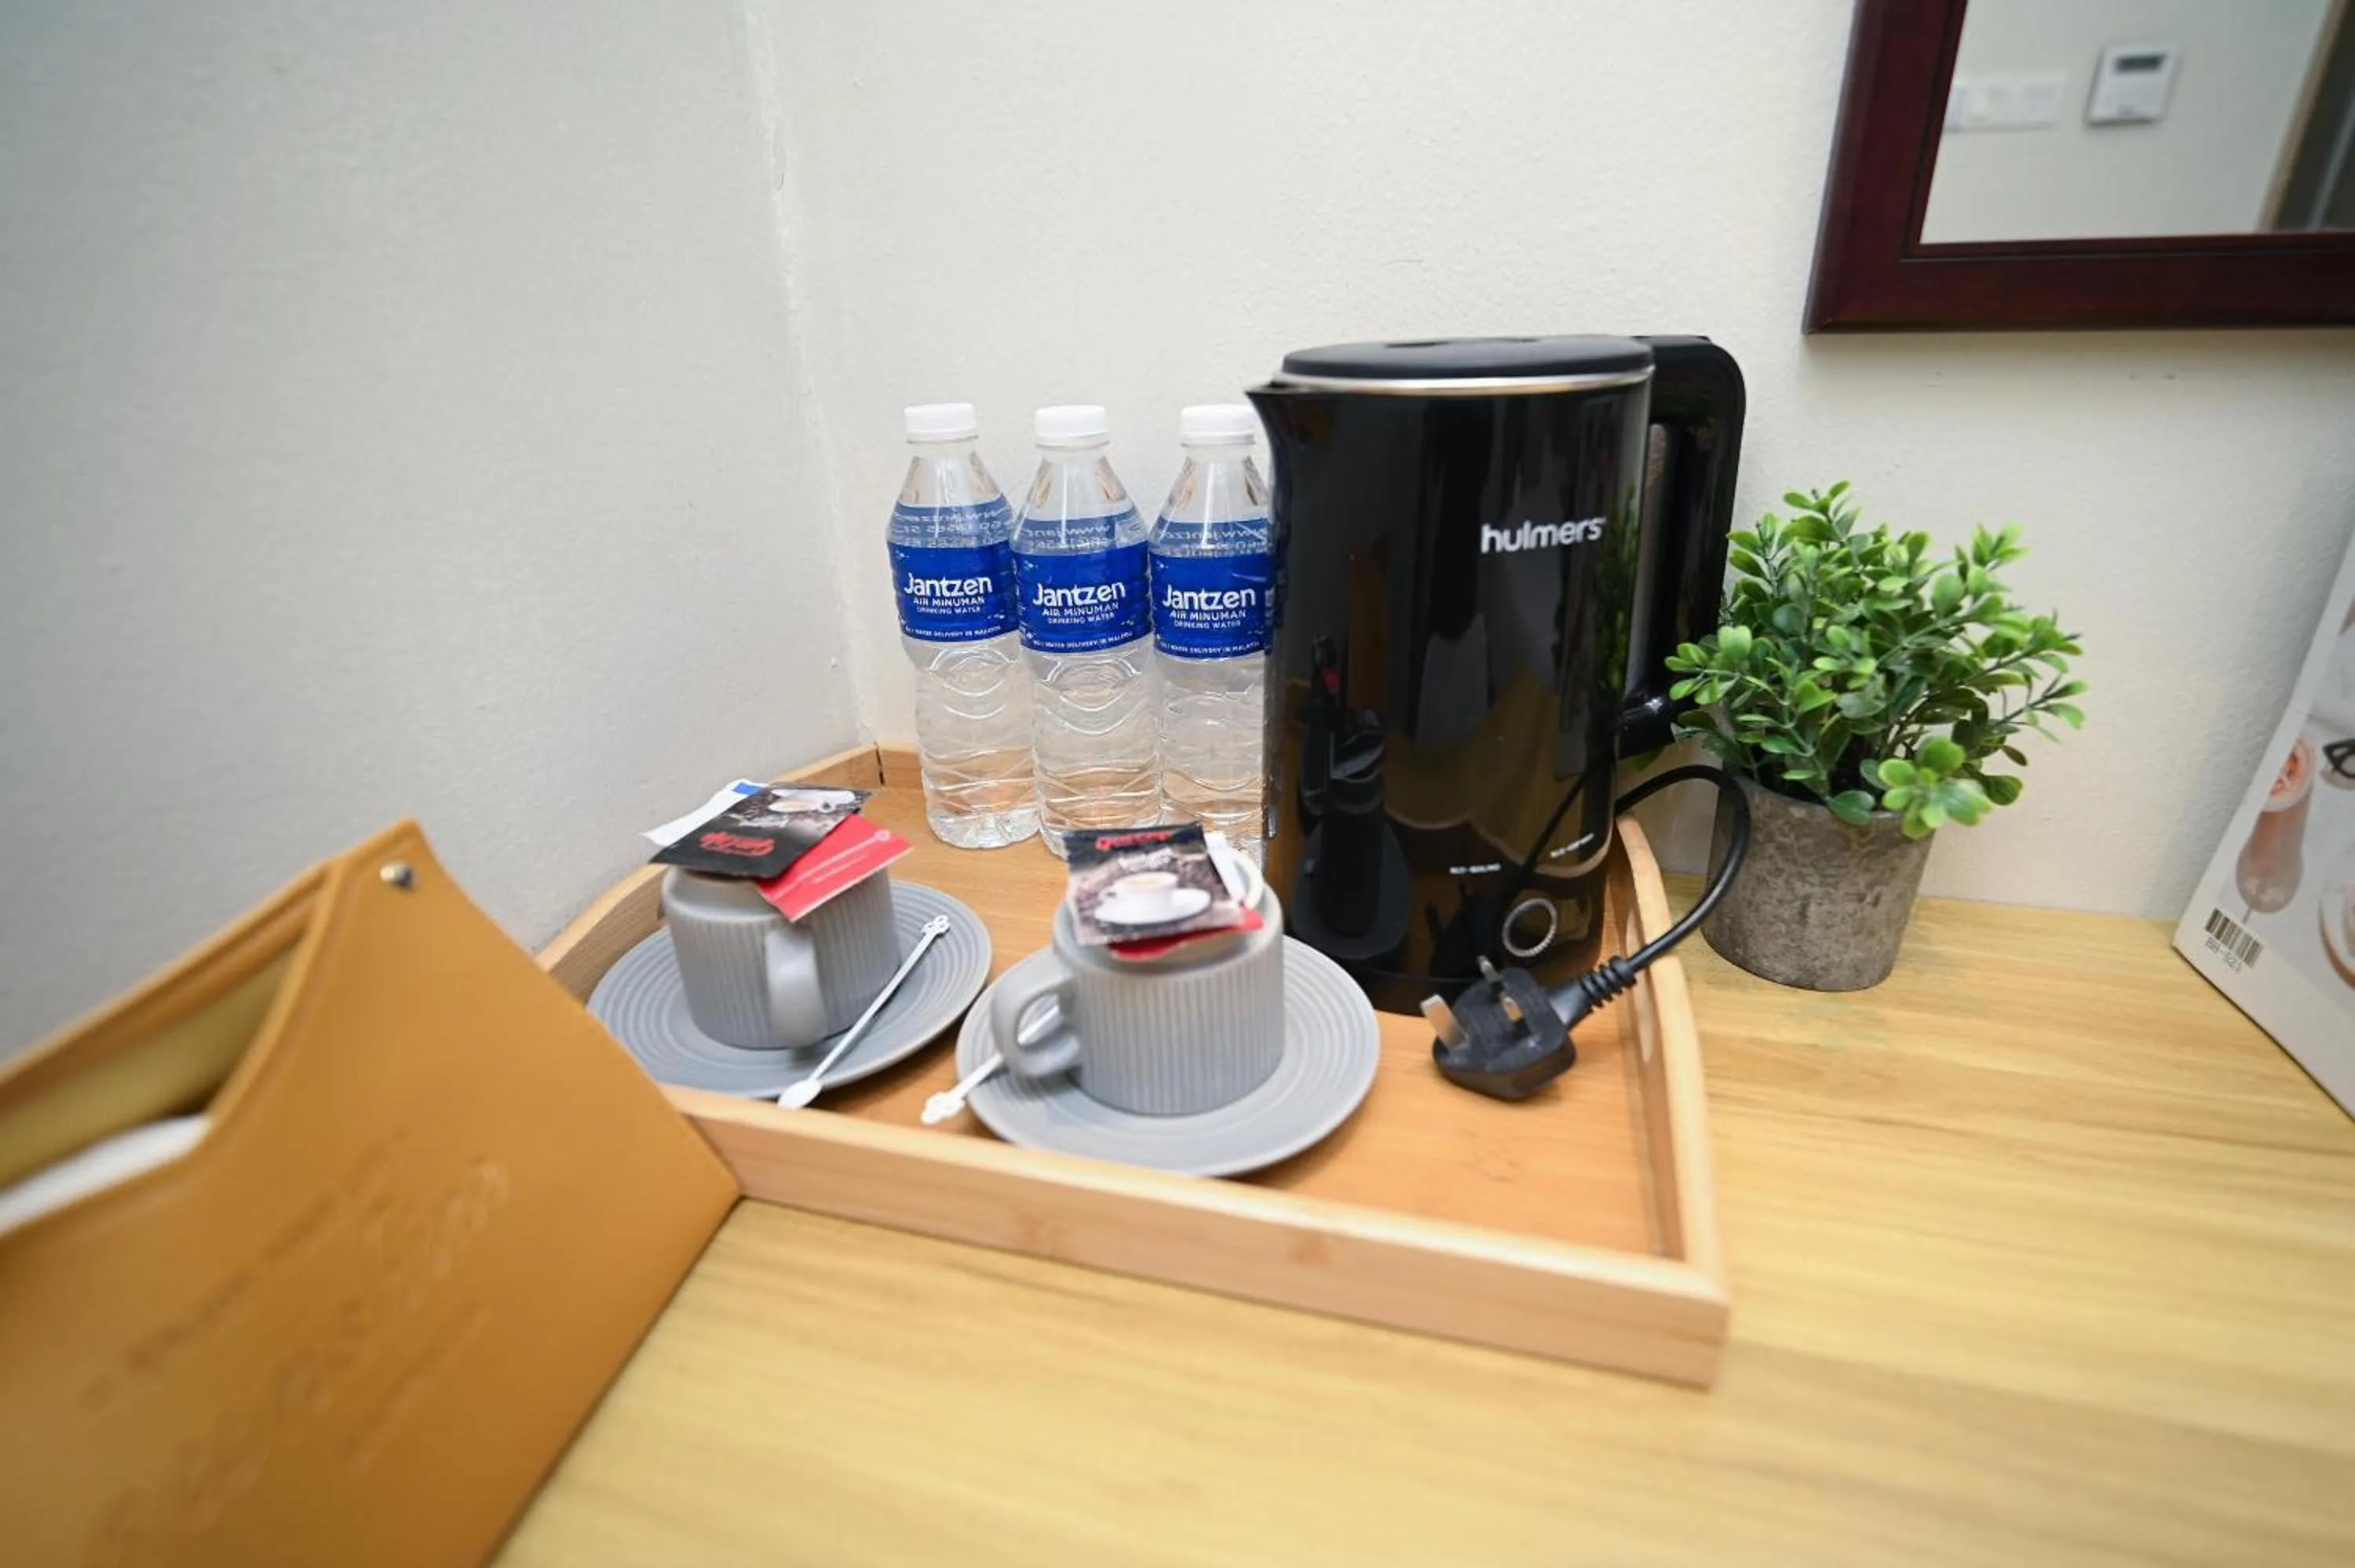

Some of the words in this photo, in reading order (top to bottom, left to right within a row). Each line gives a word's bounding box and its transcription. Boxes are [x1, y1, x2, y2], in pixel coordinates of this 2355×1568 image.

[1481, 517, 1605, 554] hulmers
[904, 572, 993, 597] Jantzen
[1032, 582, 1126, 607] Jantzen
[914, 596, 929, 606] AIR
[932, 596, 985, 607] MINUMAN
[1162, 584, 1256, 611] Jantzen
[1064, 601, 1119, 617] MINUMAN
[1169, 610, 1186, 620] AIR
[1189, 609, 1247, 621] MINUMAN
[1211, 620, 1241, 629] WATER
